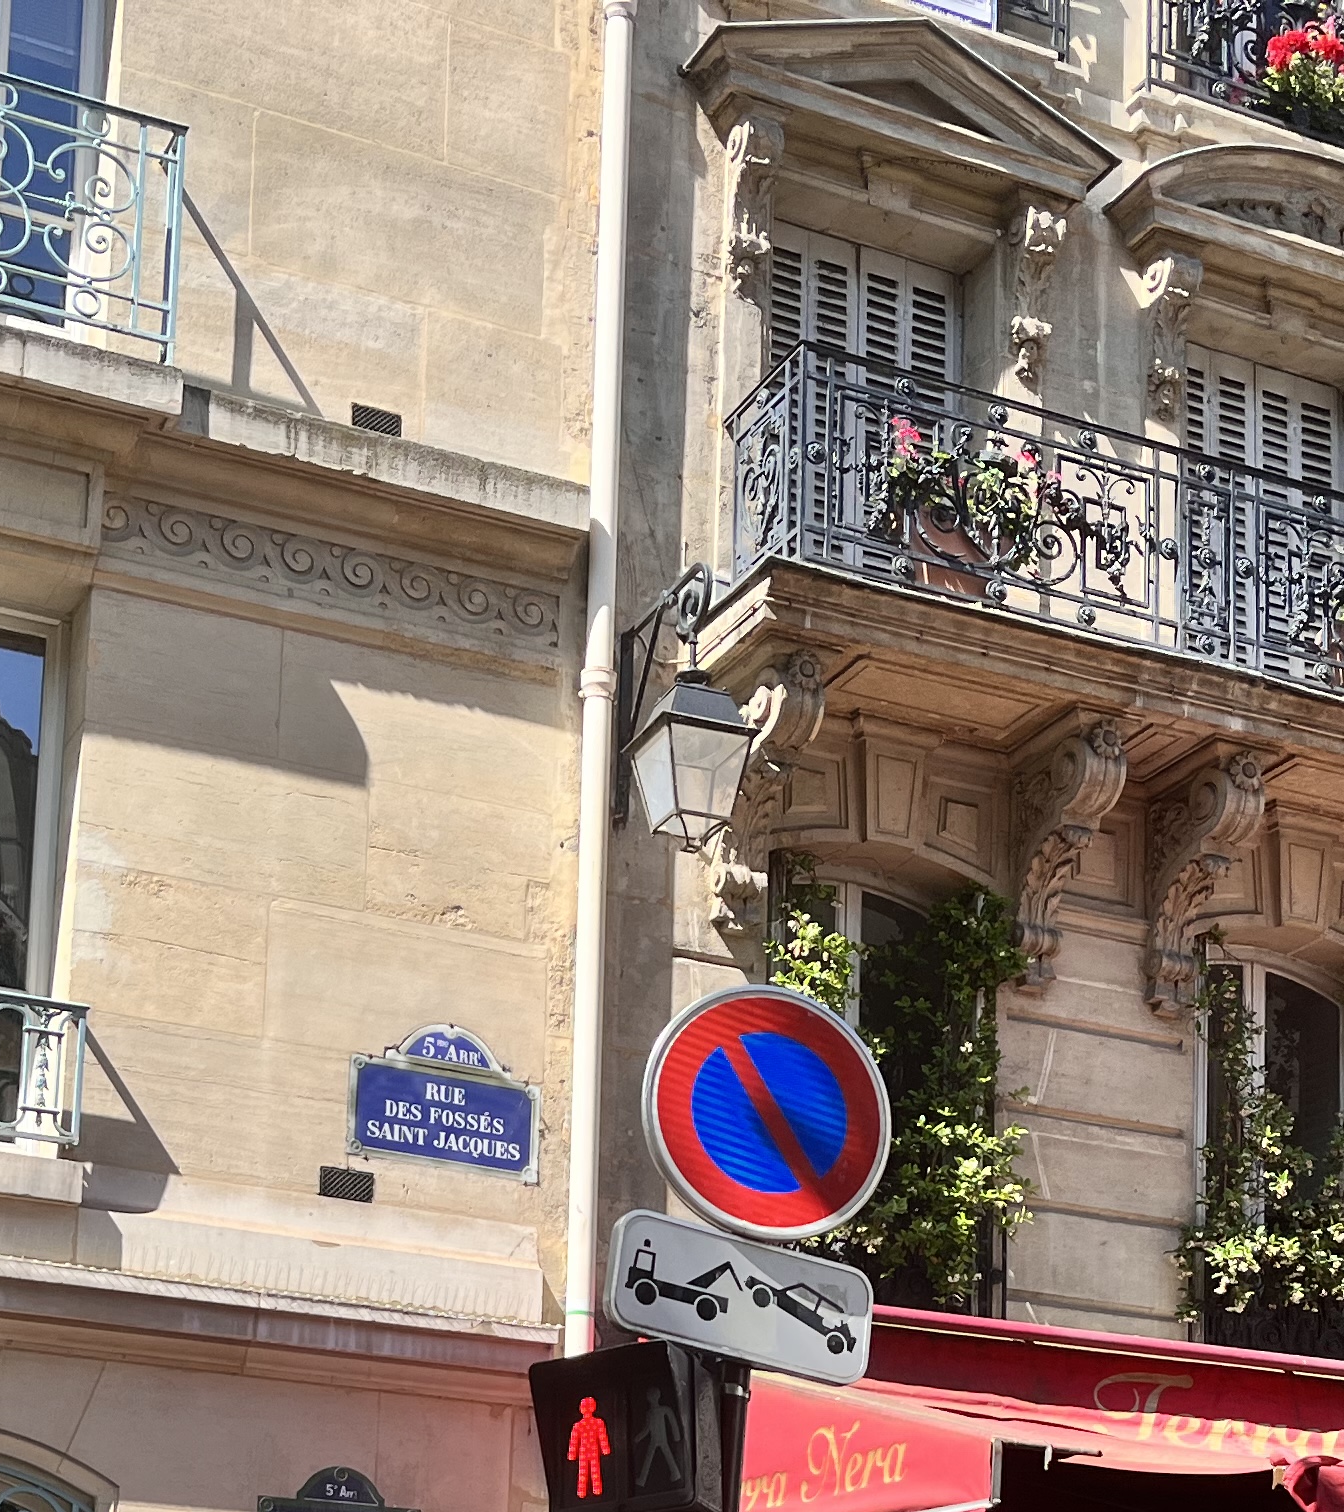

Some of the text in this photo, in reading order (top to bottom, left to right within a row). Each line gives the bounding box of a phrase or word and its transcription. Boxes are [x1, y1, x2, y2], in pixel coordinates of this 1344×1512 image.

[425, 1082, 466, 1106] RUE
[384, 1099, 505, 1136] DES FOSSÉS
[366, 1119, 521, 1161] SAINT JACQUES
[800, 1420, 907, 1503] Nera
